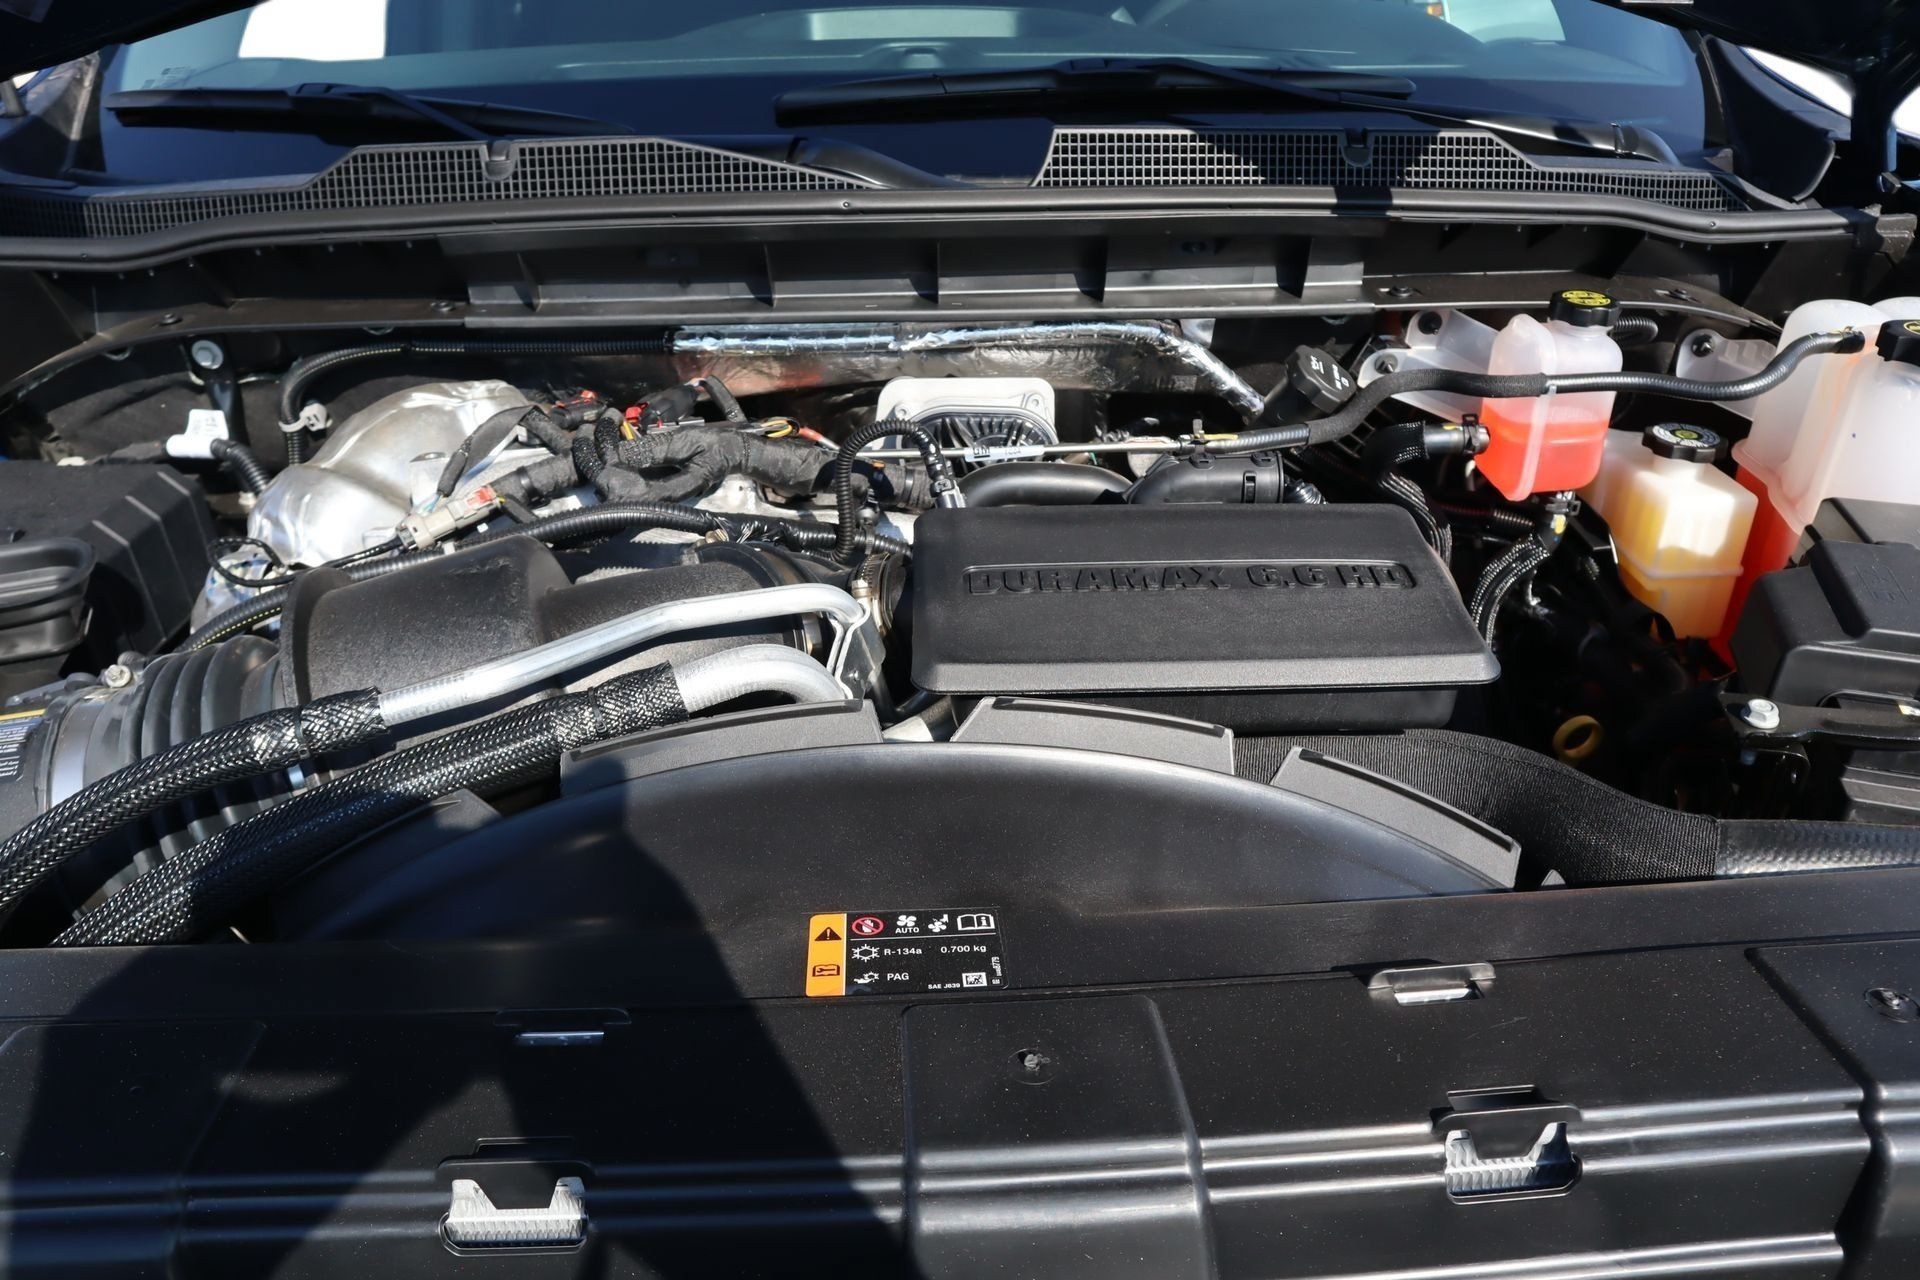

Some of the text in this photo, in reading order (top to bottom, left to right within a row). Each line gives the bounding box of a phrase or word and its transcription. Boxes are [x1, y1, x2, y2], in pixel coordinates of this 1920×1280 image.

[968, 564, 1408, 595] DURAMAX 6.6 HD
[895, 926, 920, 934] AUTO
[884, 944, 987, 956] R-134a 0.700 kg
[887, 972, 910, 981] PAG
